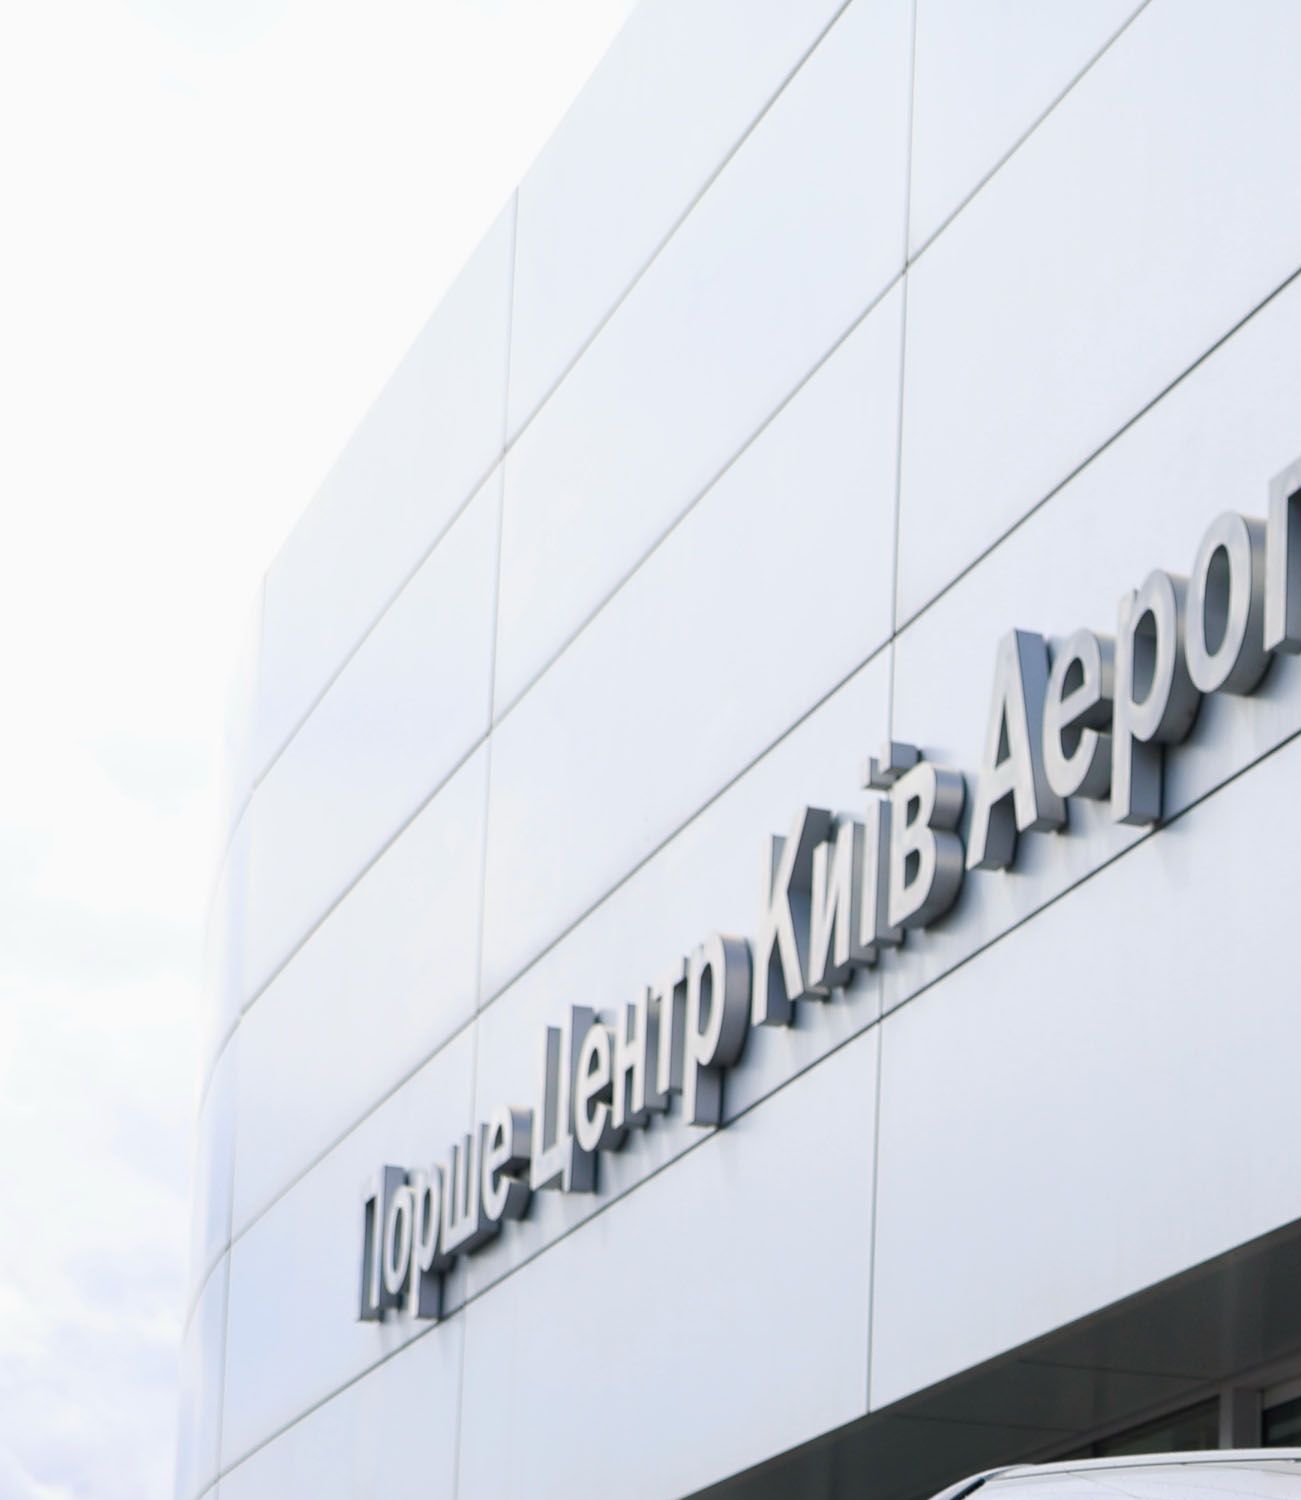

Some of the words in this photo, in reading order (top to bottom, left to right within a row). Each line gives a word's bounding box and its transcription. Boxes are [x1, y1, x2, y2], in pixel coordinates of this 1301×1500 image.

[357, 1106, 530, 1320] Порше
[531, 933, 750, 1192] Центр
[753, 742, 966, 1026] Київ
